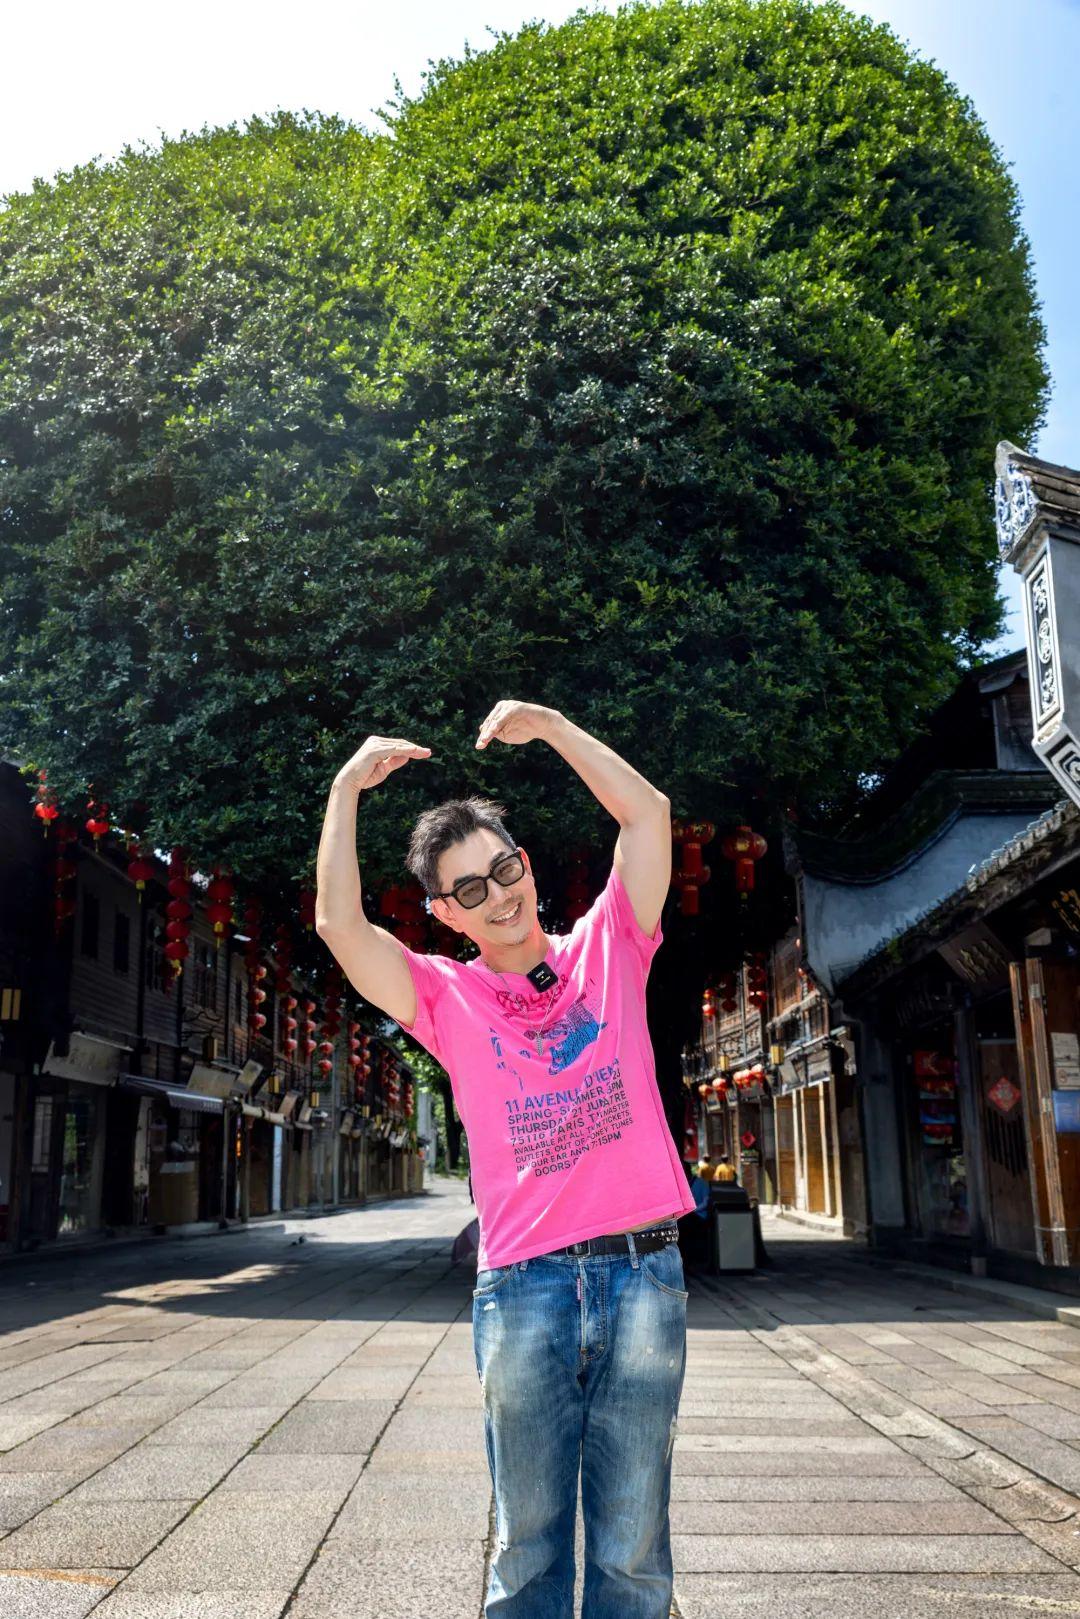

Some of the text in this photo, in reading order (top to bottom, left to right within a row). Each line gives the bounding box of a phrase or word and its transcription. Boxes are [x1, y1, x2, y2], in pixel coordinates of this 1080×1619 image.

[505, 1100, 520, 1113] 11
[525, 1087, 581, 1110] AVENU
[550, 1117, 585, 1137] PARIS
[514, 1138, 555, 1155] AVAILABLE
[557, 1134, 566, 1144] AT
[570, 1130, 584, 1139] ALL
[554, 1141, 572, 1152] OUT
[551, 1152, 567, 1163] EAR
[535, 1160, 571, 1177] DOORS
